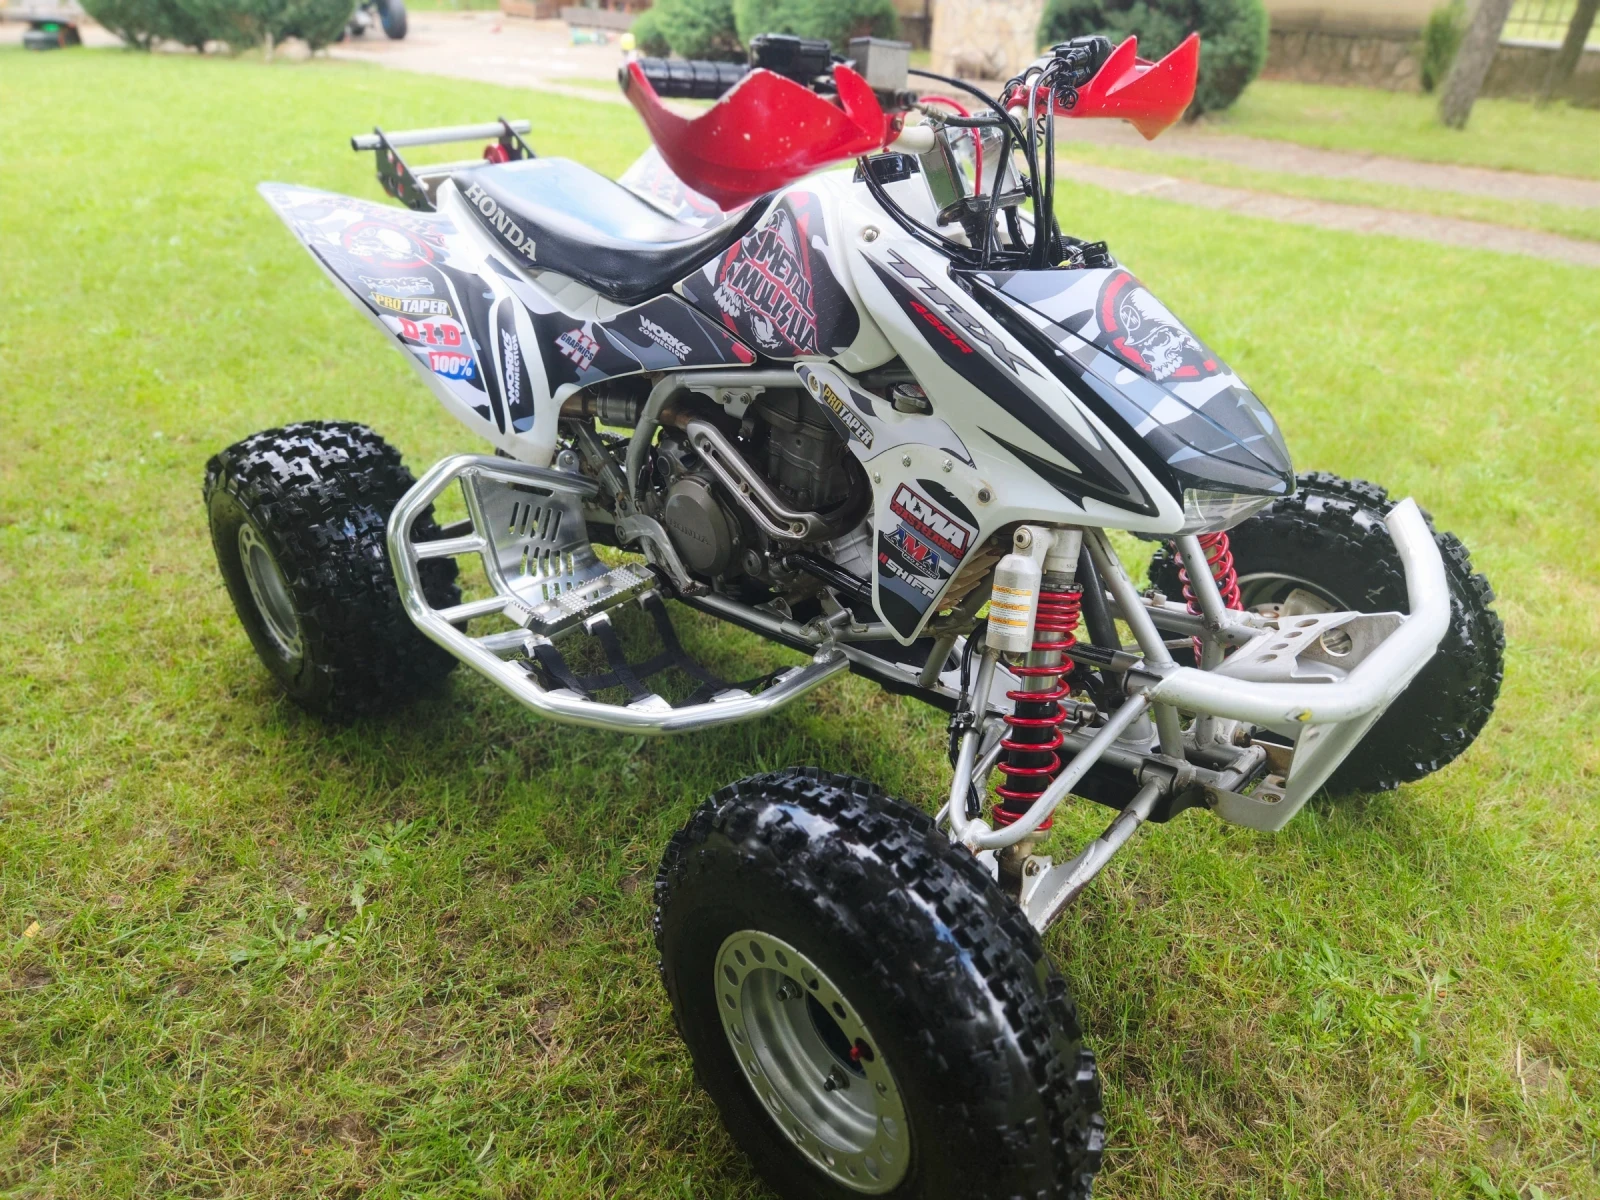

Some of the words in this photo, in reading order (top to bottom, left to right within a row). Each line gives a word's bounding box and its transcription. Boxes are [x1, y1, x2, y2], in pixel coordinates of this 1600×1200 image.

[464, 182, 537, 262] HONDA
[754, 228, 816, 319] METAL
[375, 294, 449, 314] PROTAPER
[730, 260, 816, 354] MULISHA
[887, 248, 1047, 381] TRX
[910, 301, 973, 354] 450R
[560, 332, 595, 361] GRAPHICS
[638, 326, 686, 361] CONNECTION
[640, 314, 692, 354] WORKS
[431, 355, 473, 377] 100%
[501, 328, 514, 406] WORKS
[823, 387, 873, 446] PROTAPER
[884, 525, 940, 577] AMA
[886, 558, 935, 597] SHIFT
